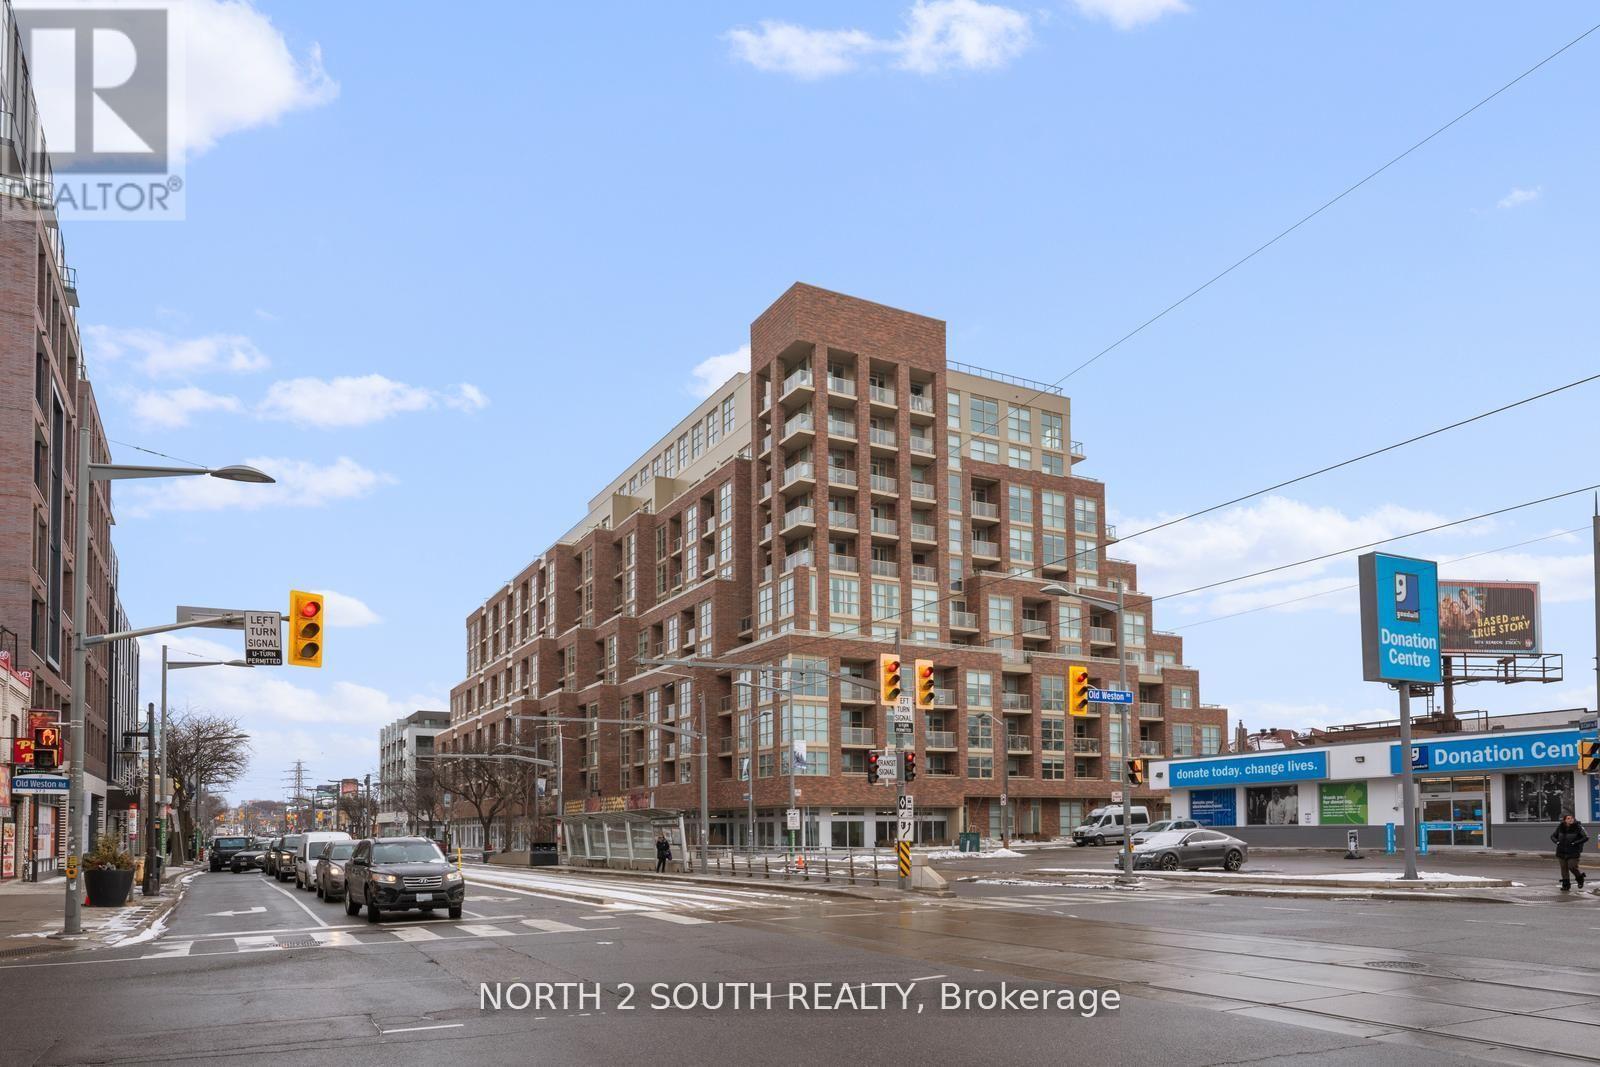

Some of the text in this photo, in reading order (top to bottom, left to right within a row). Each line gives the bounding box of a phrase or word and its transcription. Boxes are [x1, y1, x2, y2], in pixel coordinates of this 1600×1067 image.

[250, 616, 274, 625] LEFT
[1477, 615, 1509, 628] BASED
[250, 628, 276, 636] TURN
[1472, 620, 1530, 638] TRUE STORY
[248, 639, 279, 648] SIGNAL
[1381, 627, 1437, 650] Donation
[1389, 648, 1431, 668] Centre
[1088, 690, 1100, 699] Old
[1102, 691, 1125, 701] Weston
[895, 714, 912, 722] SIGNAL
[1434, 746, 1523, 766] Donation
[1176, 760, 1318, 780] donate today. change lives.
[16, 780, 28, 788] Old
